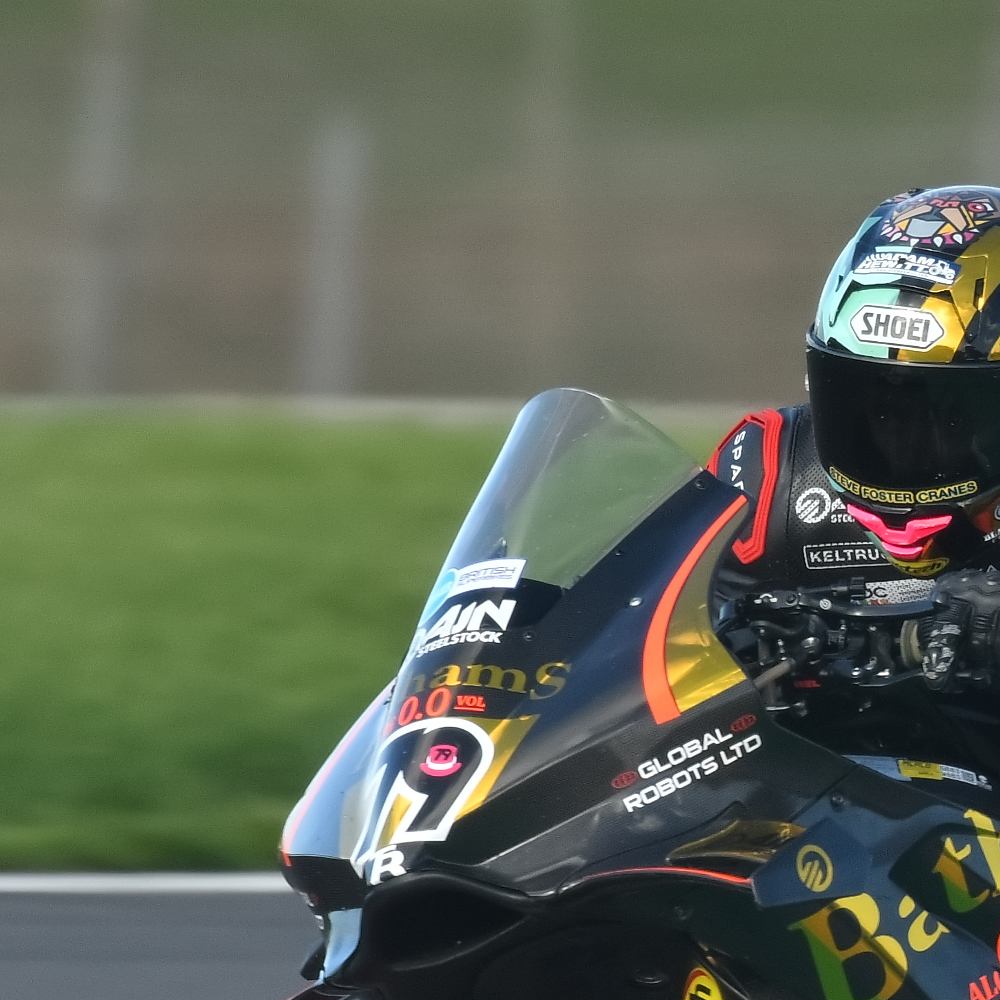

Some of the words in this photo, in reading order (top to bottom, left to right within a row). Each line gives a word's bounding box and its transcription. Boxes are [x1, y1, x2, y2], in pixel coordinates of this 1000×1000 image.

[861, 312, 930, 343] SHOEI
[830, 468, 860, 494] STEVE
[862, 487, 914, 503] FOSTER
[917, 482, 977, 503] CRANES
[808, 547, 886, 564] KELTRU
[416, 630, 504, 659] STEELSTOCK
[455, 694, 487, 708] VOL
[637, 728, 734, 779] GLOBAL
[622, 755, 719, 813] ROBOTS
[719, 733, 763, 766] LTD
